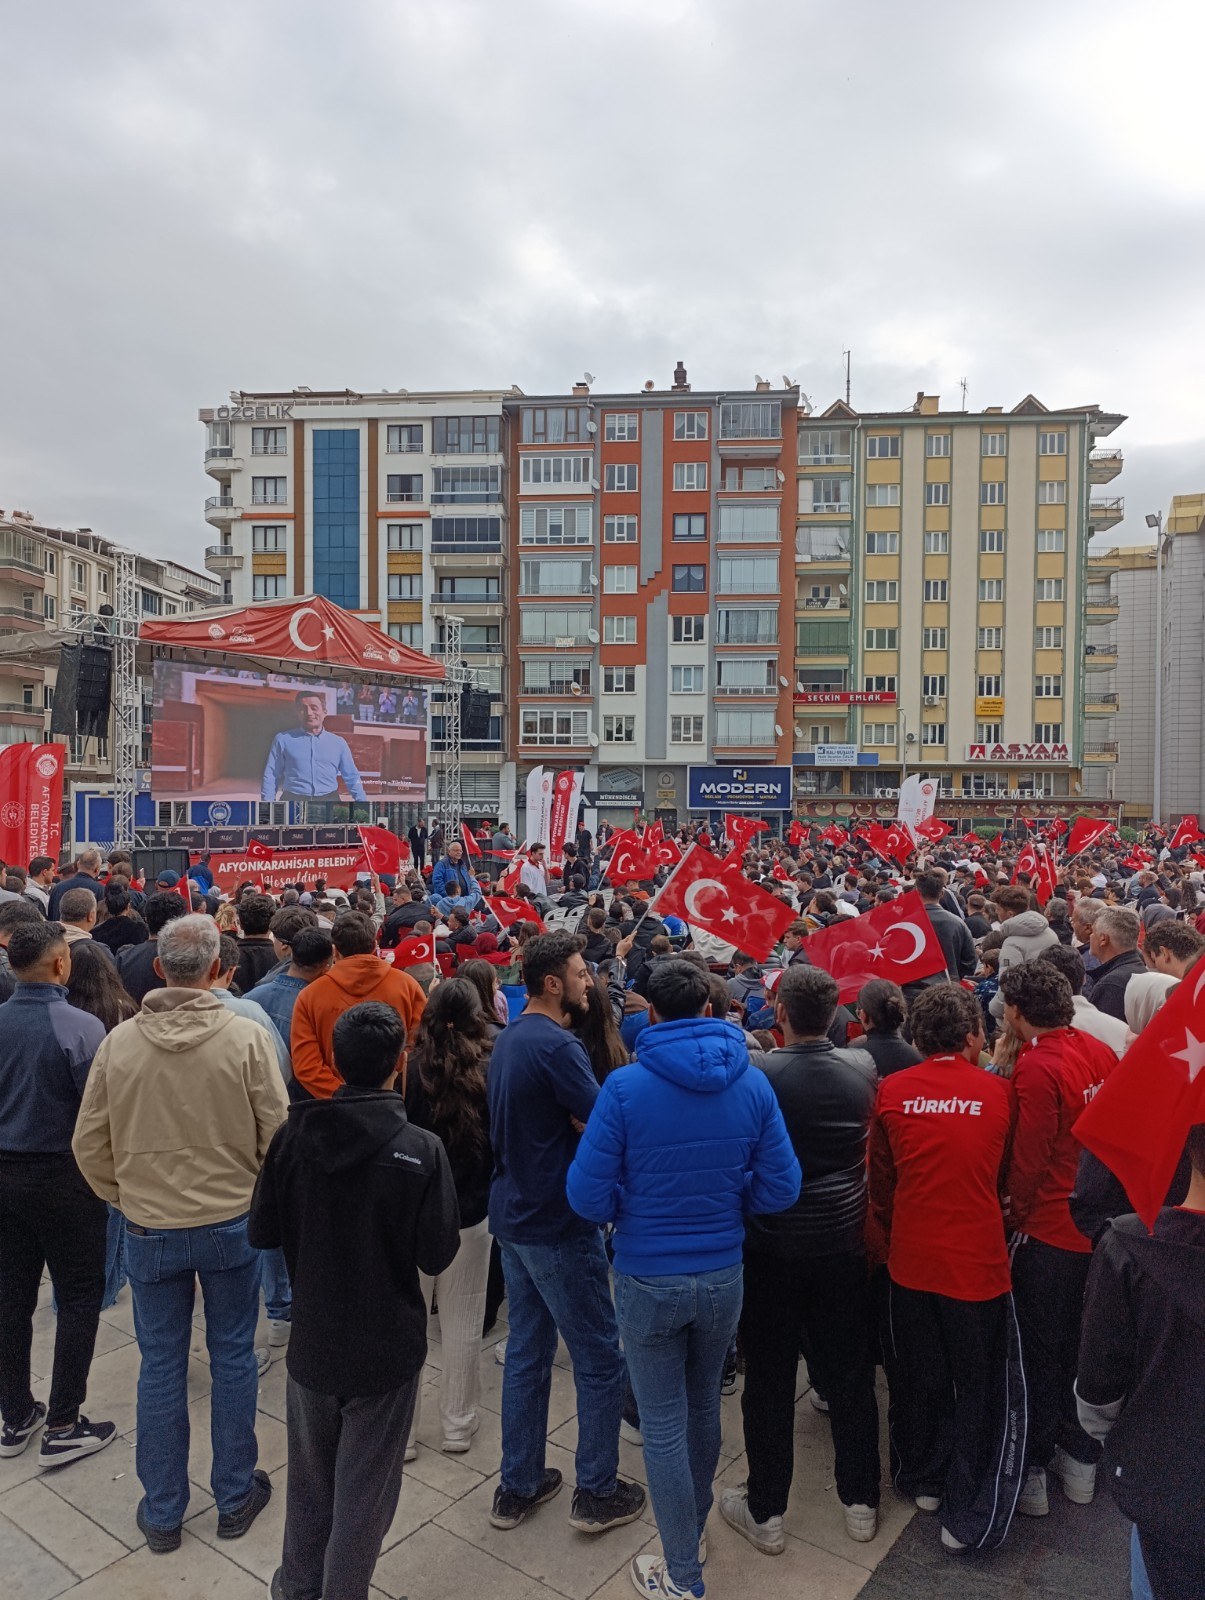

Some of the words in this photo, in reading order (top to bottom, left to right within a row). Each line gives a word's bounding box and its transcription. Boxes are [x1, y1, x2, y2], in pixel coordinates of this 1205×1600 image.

[807, 694, 840, 703] SEÇKİN
[849, 694, 881, 702] EMLAK
[990, 743, 1069, 754] ASYAM
[699, 783, 782, 794] MODERN
[987, 788, 1045, 799] EKMEK
[50, 821, 60, 839] T.C.
[218, 857, 315, 873] AFYONKARAHİSAR
[317, 854, 357, 868] BELEDİY
[903, 1096, 982, 1116] TÜRKİYE
